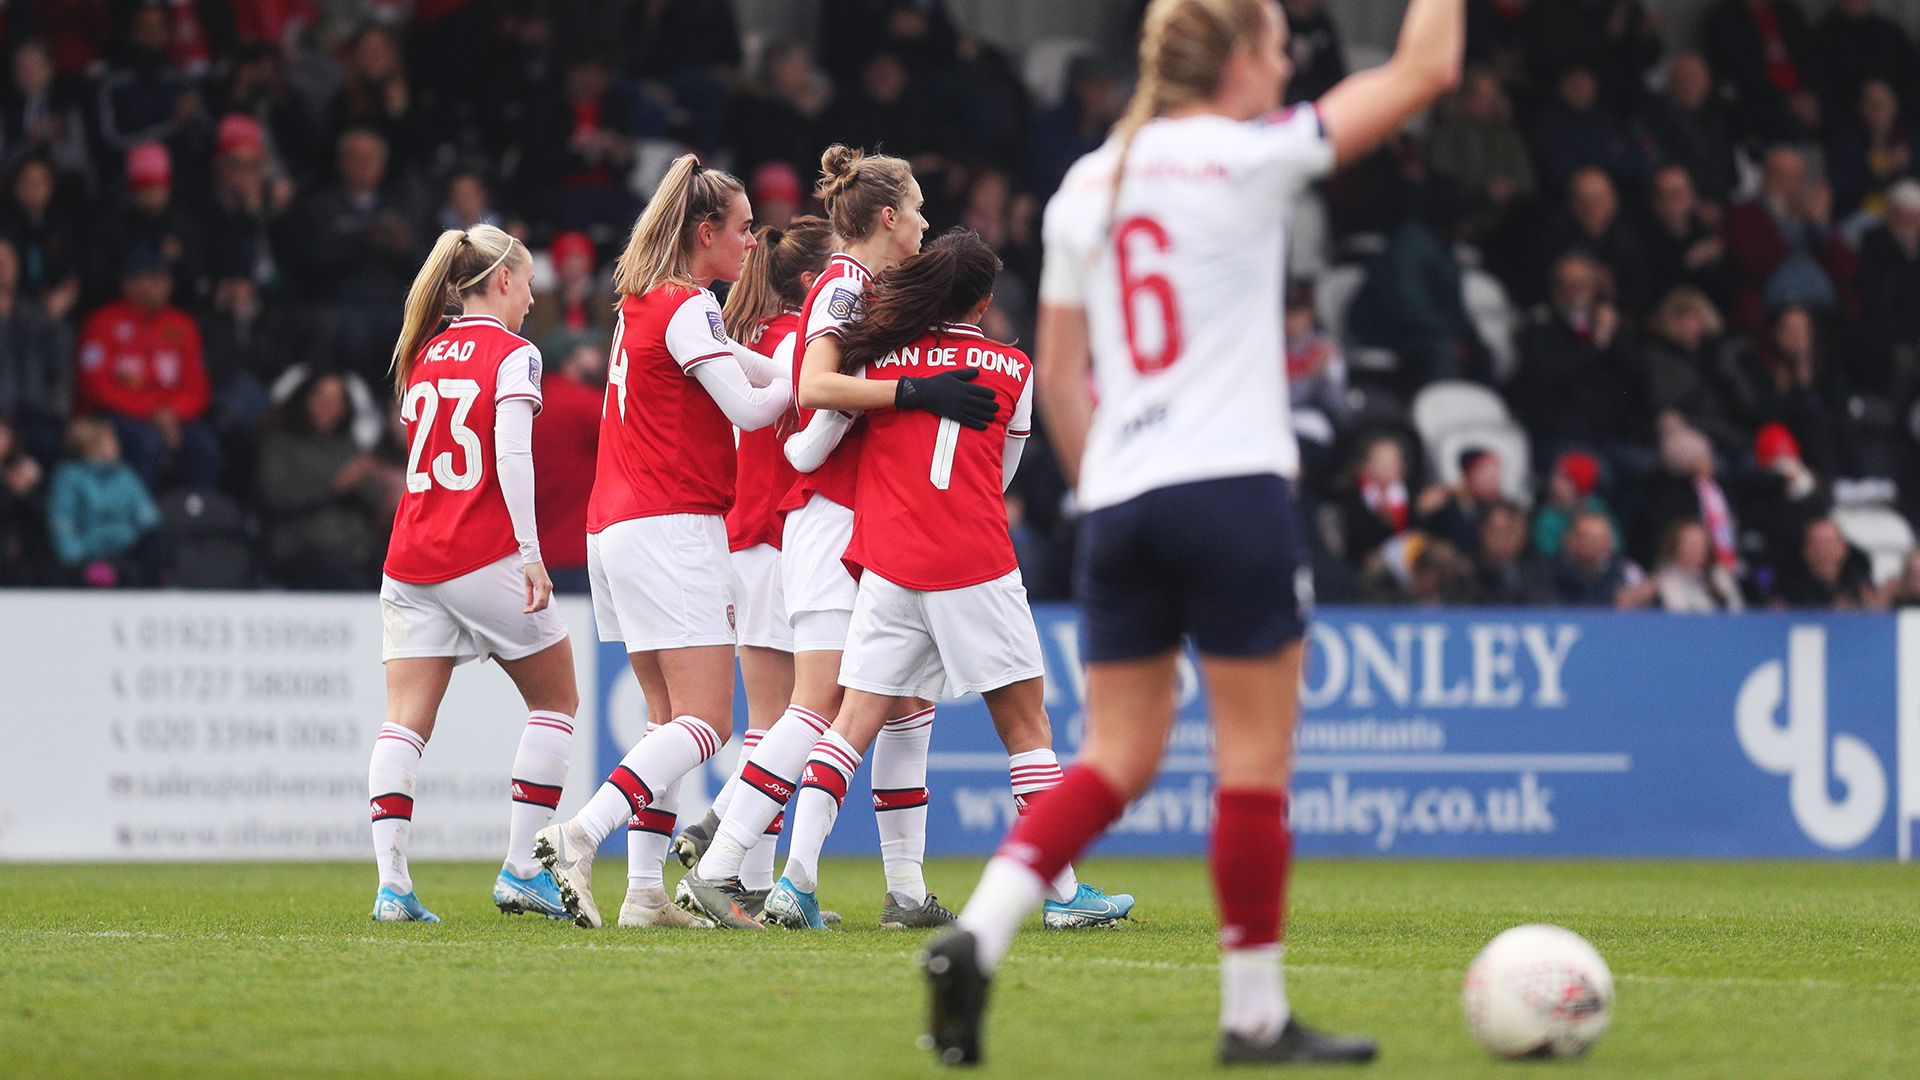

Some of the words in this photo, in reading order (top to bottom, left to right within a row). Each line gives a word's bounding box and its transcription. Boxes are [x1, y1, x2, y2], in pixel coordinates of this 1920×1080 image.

[1113, 215, 1186, 378] 6
[423, 340, 476, 365] MEAD
[927, 347, 959, 367] DE
[965, 347, 1025, 382] DONK
[407, 378, 484, 494] 23
[1298, 621, 1581, 707] ONLEY
